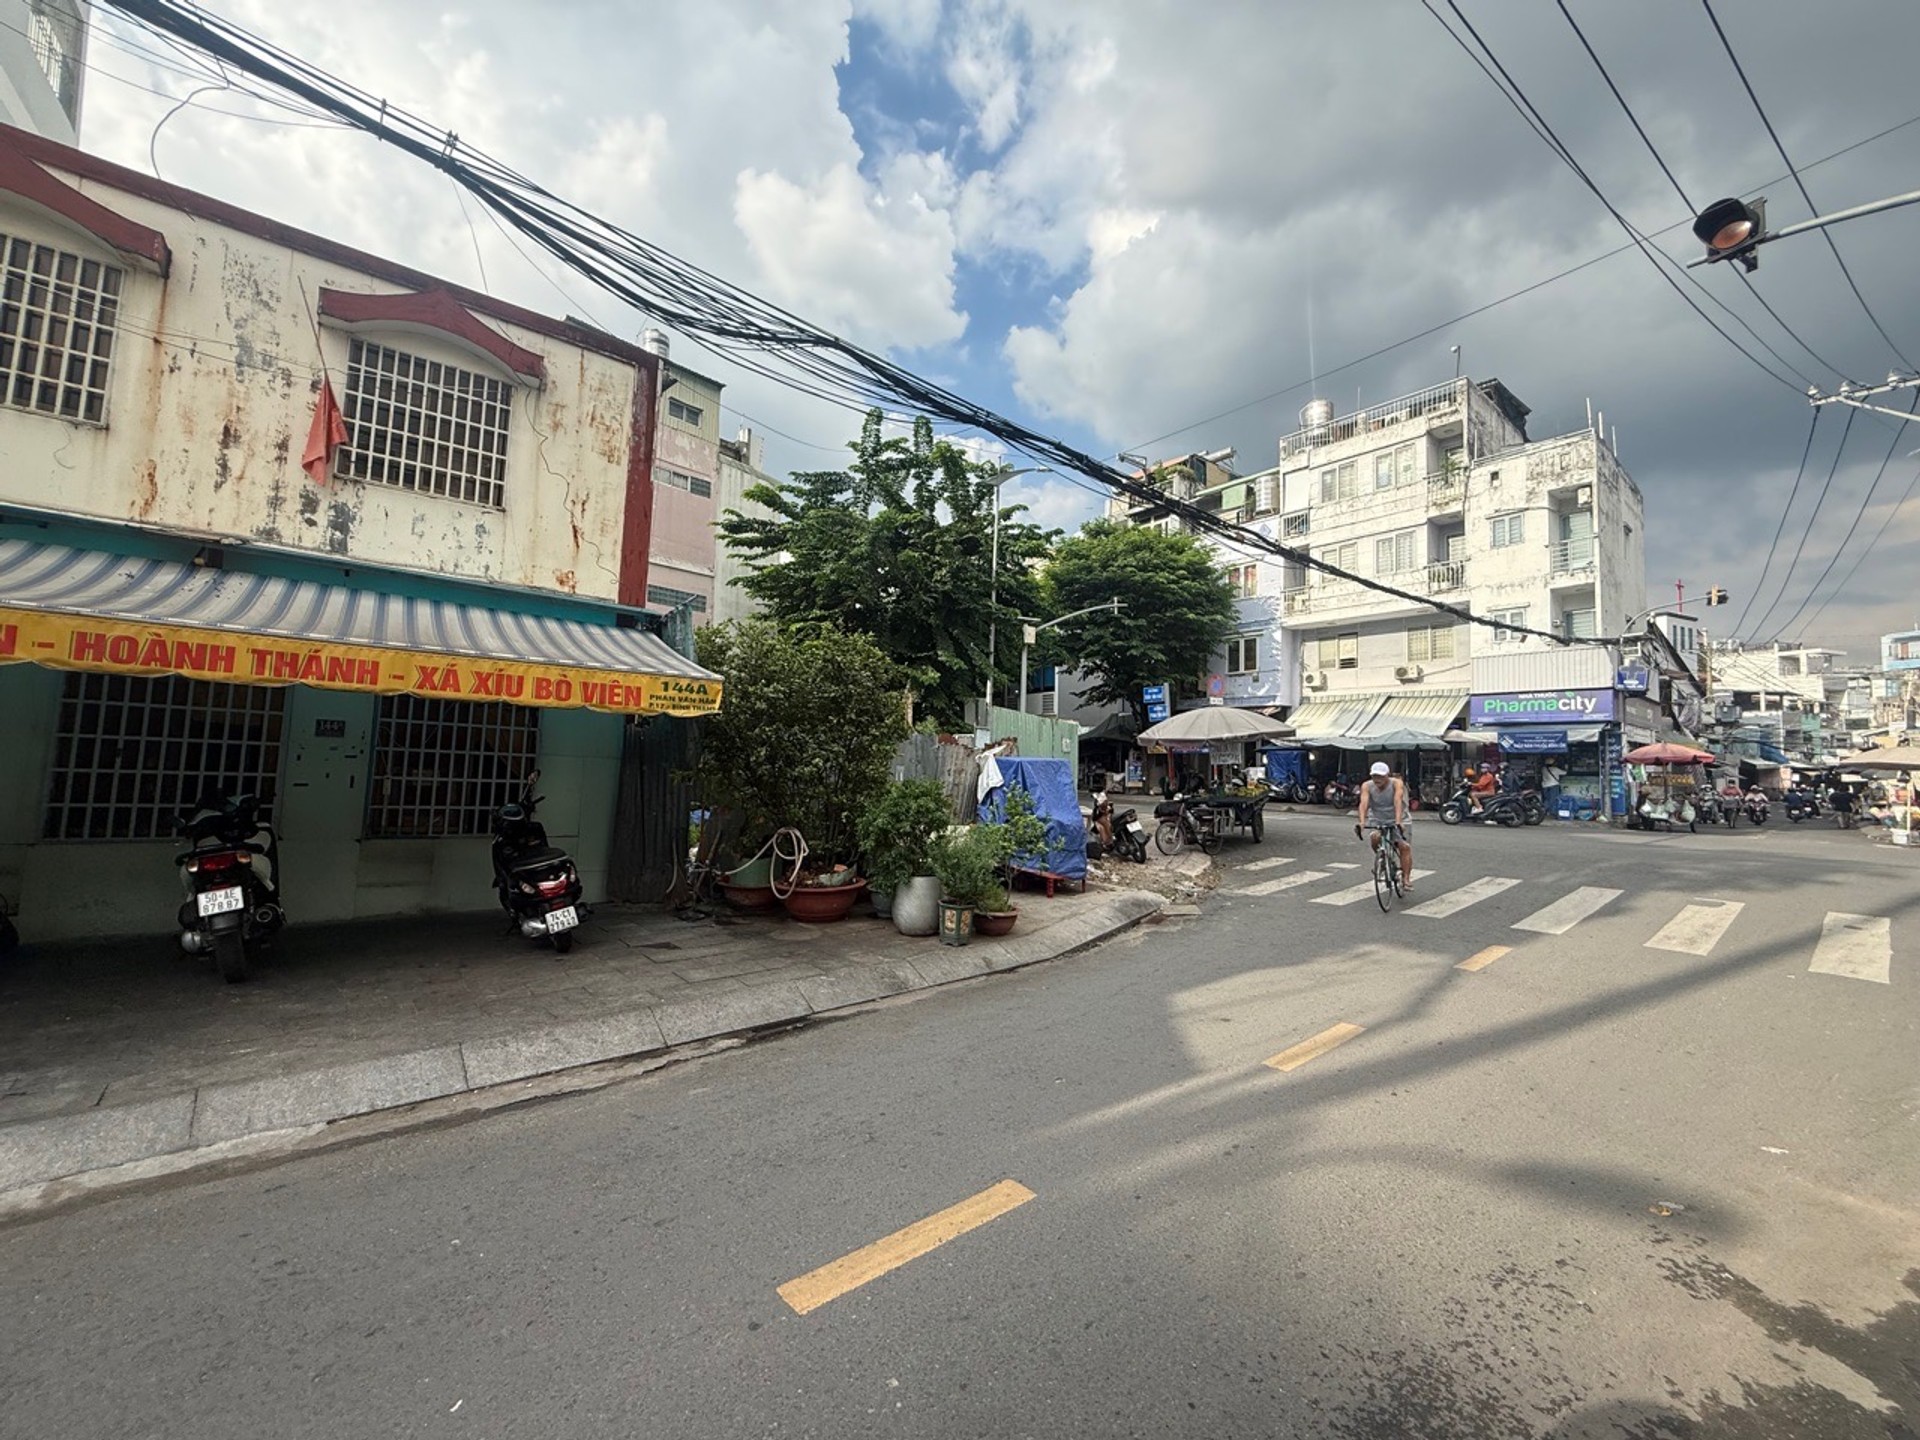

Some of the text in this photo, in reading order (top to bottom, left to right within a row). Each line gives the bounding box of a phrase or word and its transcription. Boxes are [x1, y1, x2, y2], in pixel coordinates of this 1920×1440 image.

[70, 631, 236, 673] HOÀNH
[248, 647, 380, 686] THÁNH
[414, 663, 462, 693] XÁ
[470, 668, 525, 698] XÍU
[532, 673, 572, 702] BÒ
[580, 680, 642, 708] VIÊN
[661, 681, 708, 695] 144A
[1484, 695, 1597, 713] Pharmacity
